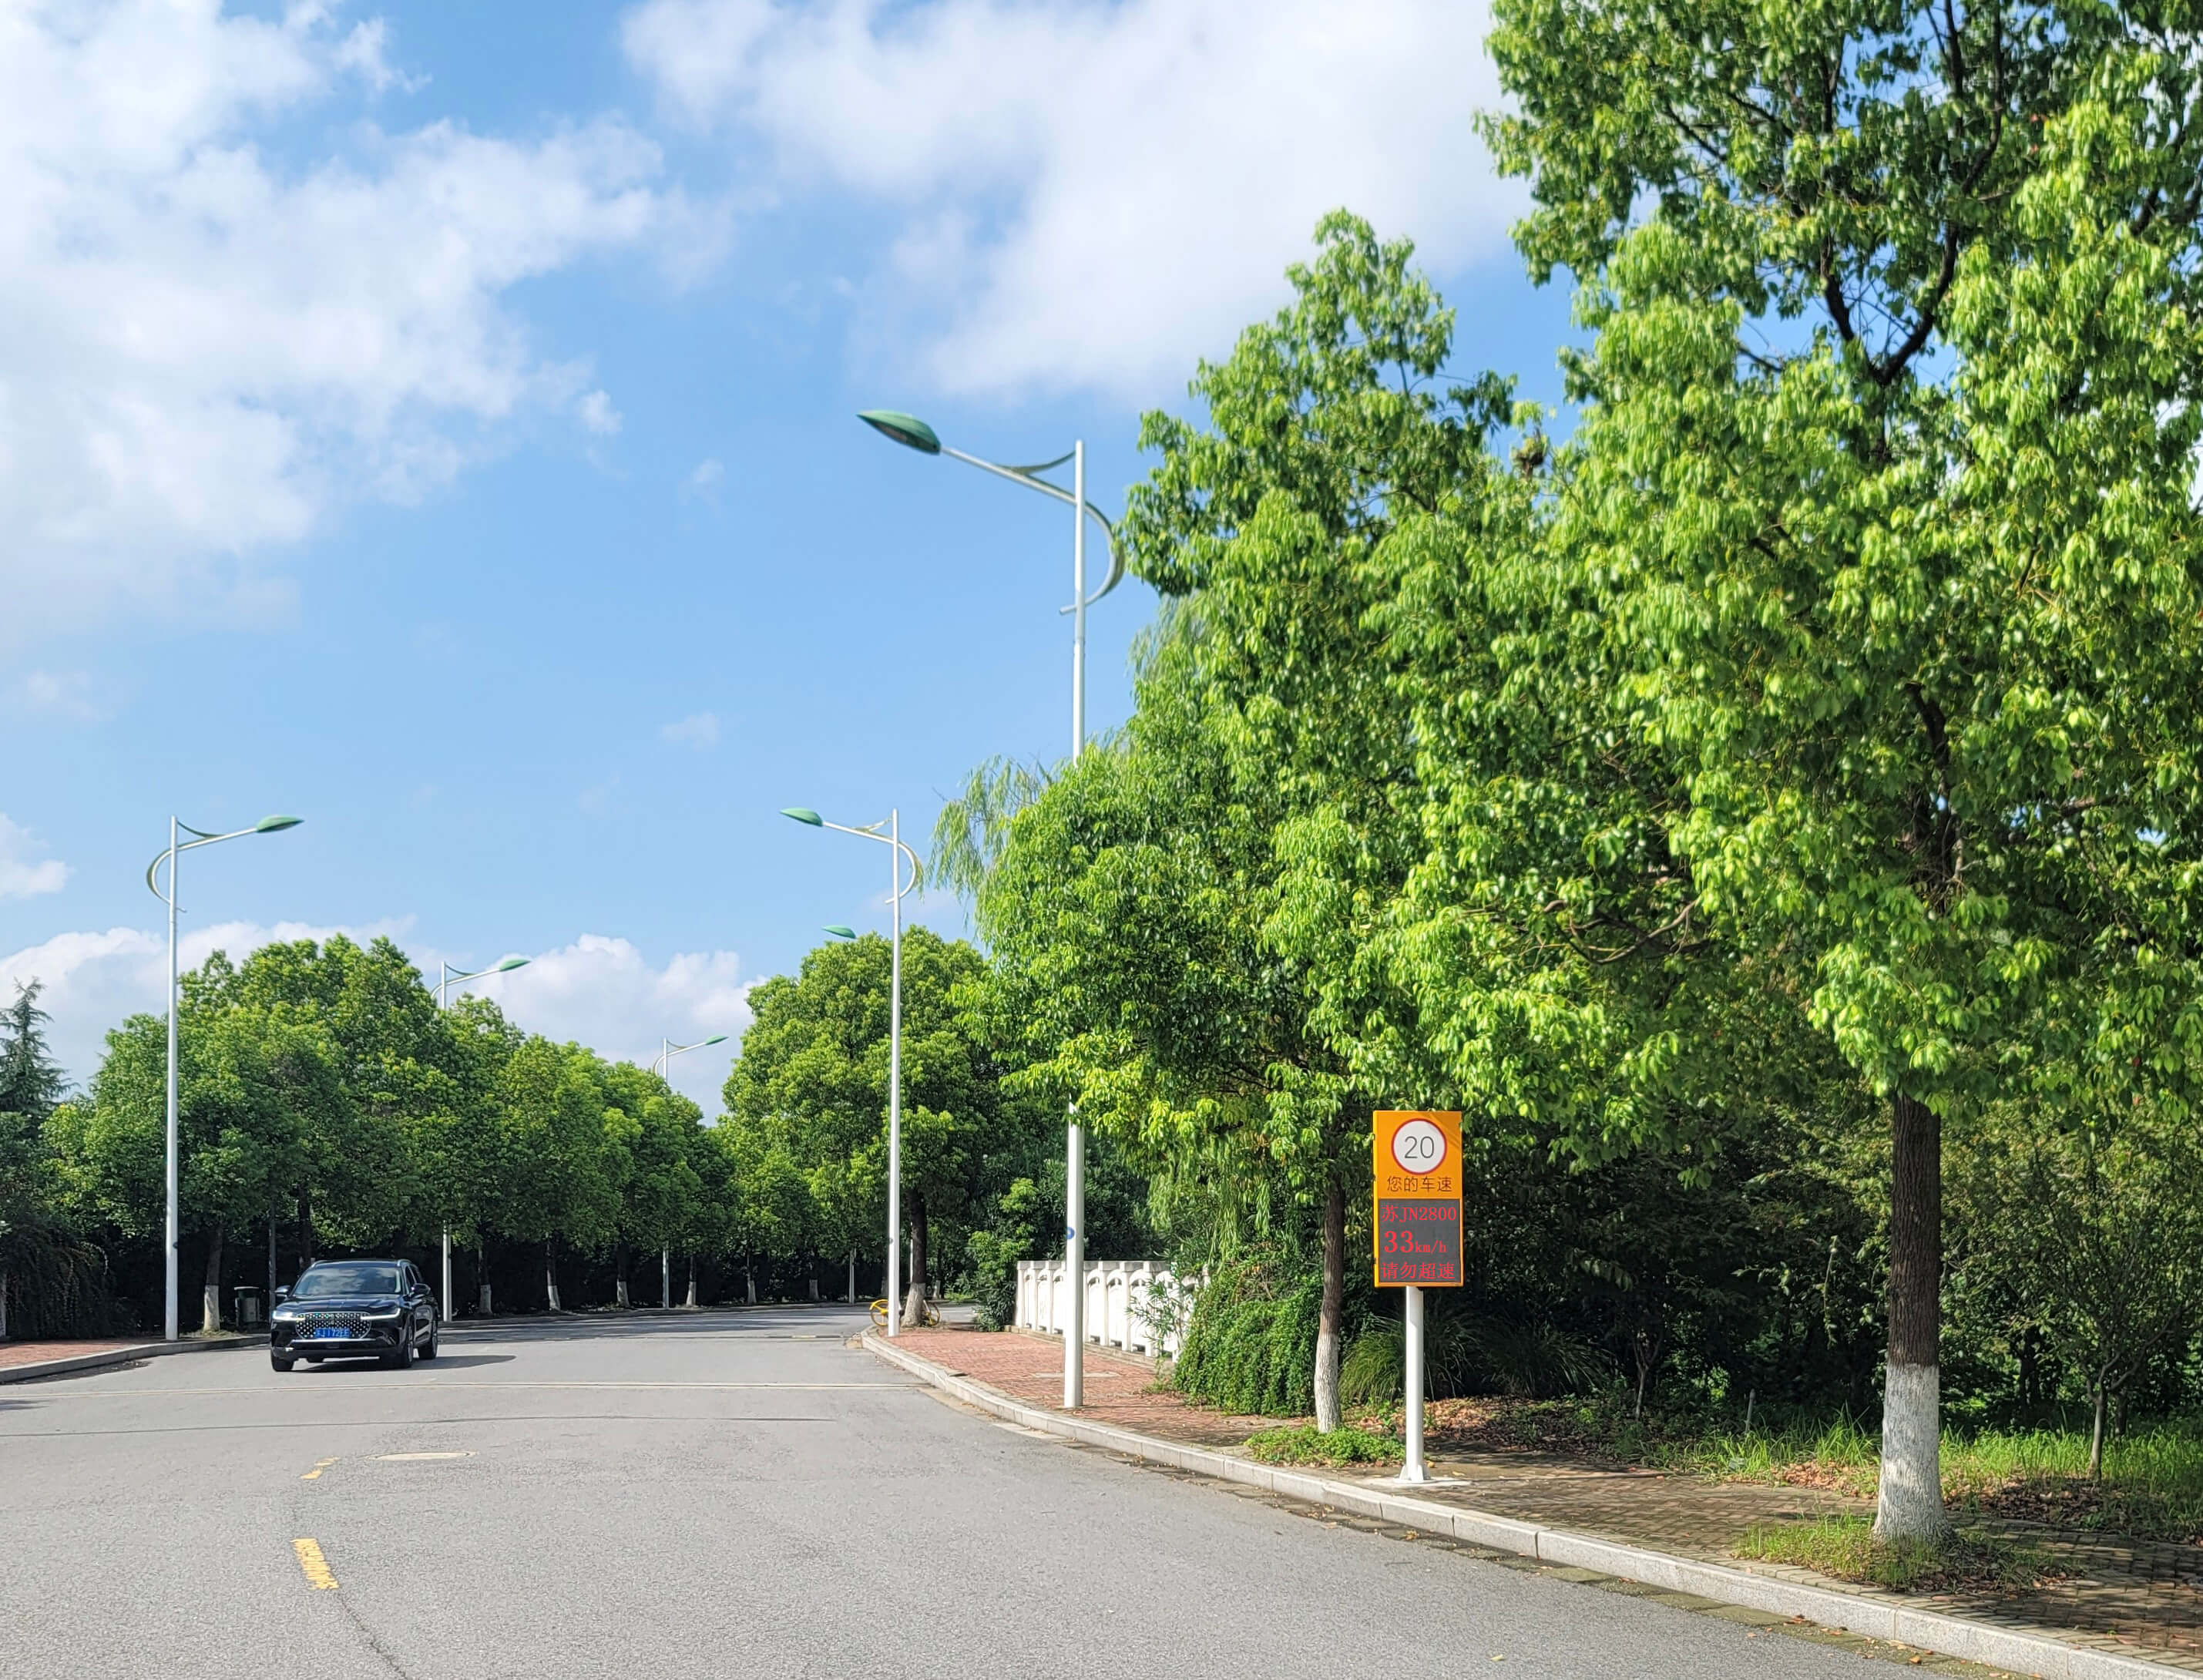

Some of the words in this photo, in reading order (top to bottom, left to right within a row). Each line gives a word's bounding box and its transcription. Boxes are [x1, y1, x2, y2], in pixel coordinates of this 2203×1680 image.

[1404, 1136, 1435, 1159] 20
[1387, 1175, 1452, 1193] 您的车速
[1381, 1205, 1457, 1224] 苏JN2800
[1380, 1262, 1456, 1280] 请勿超速
